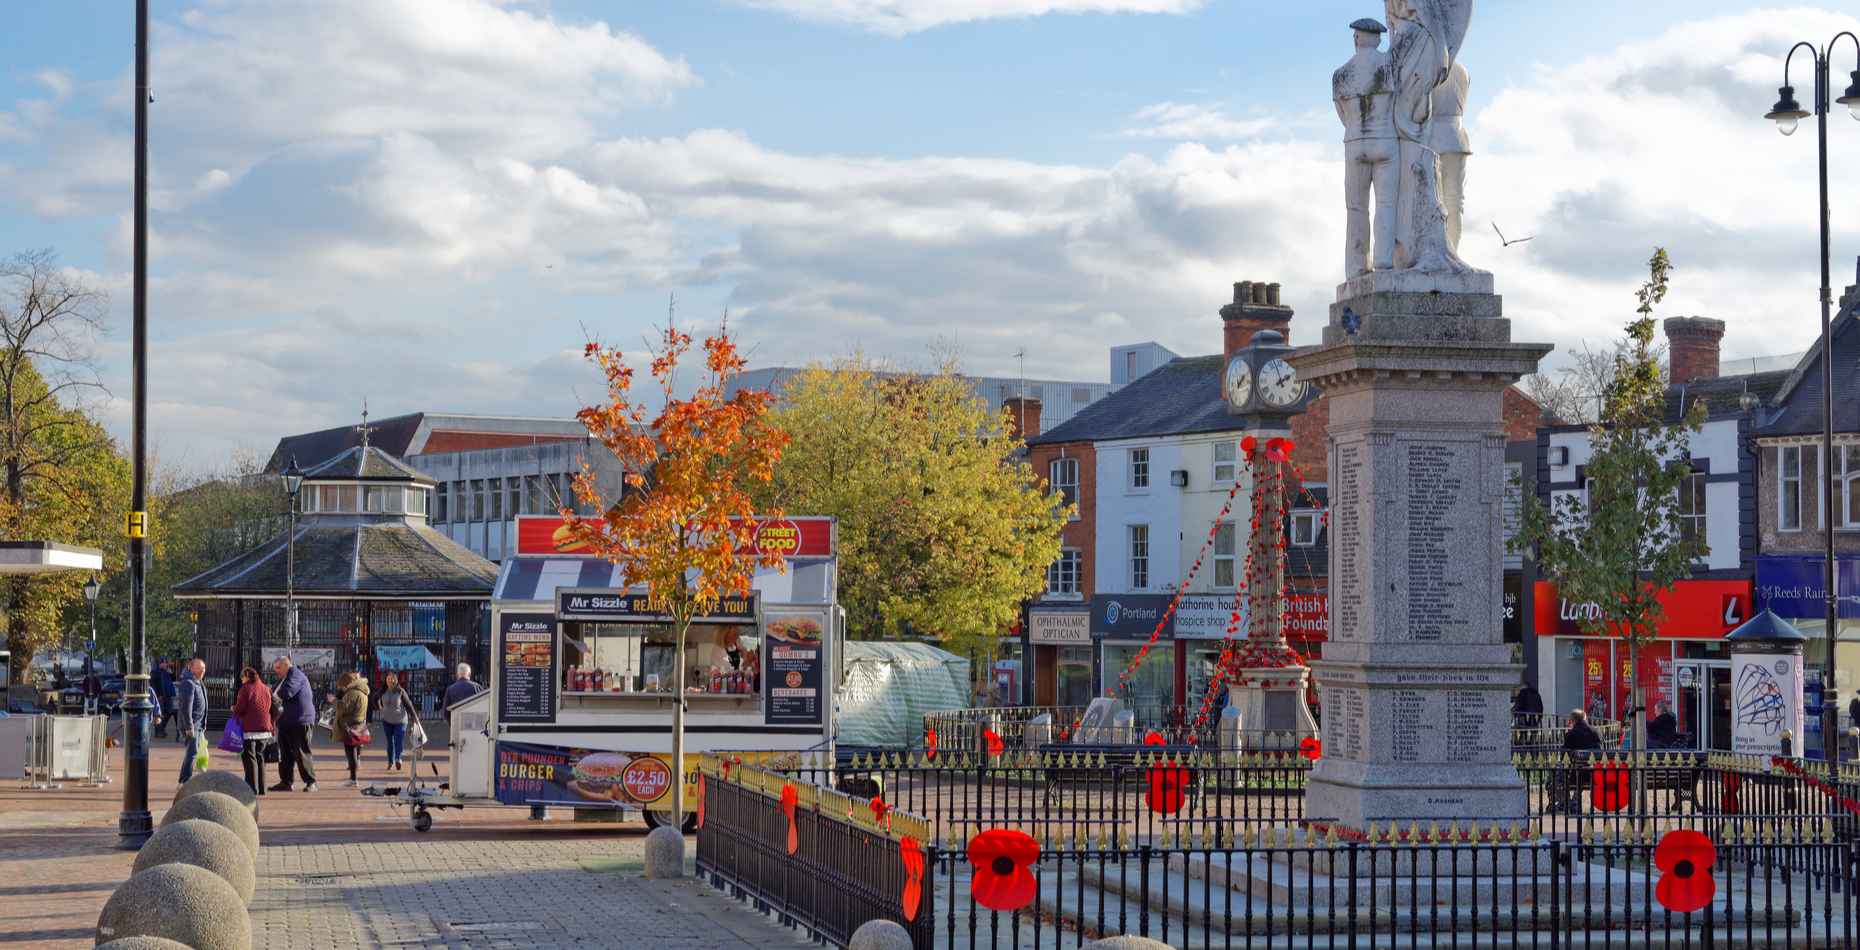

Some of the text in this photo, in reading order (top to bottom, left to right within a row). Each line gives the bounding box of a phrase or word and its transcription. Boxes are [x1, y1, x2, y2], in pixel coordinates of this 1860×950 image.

[128, 515, 144, 534] H
[760, 528, 796, 538] STREET
[759, 538, 796, 550] FOOD
[1774, 586, 1827, 599] Reeds Rain
[570, 597, 628, 608] Mr Sizzle
[1175, 597, 1243, 610] katharine house
[1284, 597, 1320, 613] British
[1505, 592, 1516, 606] bjb
[723, 601, 748, 613] YOU!
[1122, 607, 1156, 619] Portland
[1037, 616, 1086, 627] OPHTHALMIC
[1176, 614, 1225, 629] hospice shop
[1286, 616, 1328, 630] Founda
[1043, 629, 1080, 639] OPTICIAN
[1588, 662, 1603, 676] 25%
[1735, 736, 1749, 745] Bring
[1747, 744, 1781, 752] prescriptio
[500, 751, 565, 765] QTR POUNDER
[500, 763, 553, 780] BURGER
[627, 770, 666, 785] £2.50
[500, 779, 542, 791] & CHIPS
[638, 786, 654, 795] EACH
[688, 786, 695, 797] &
